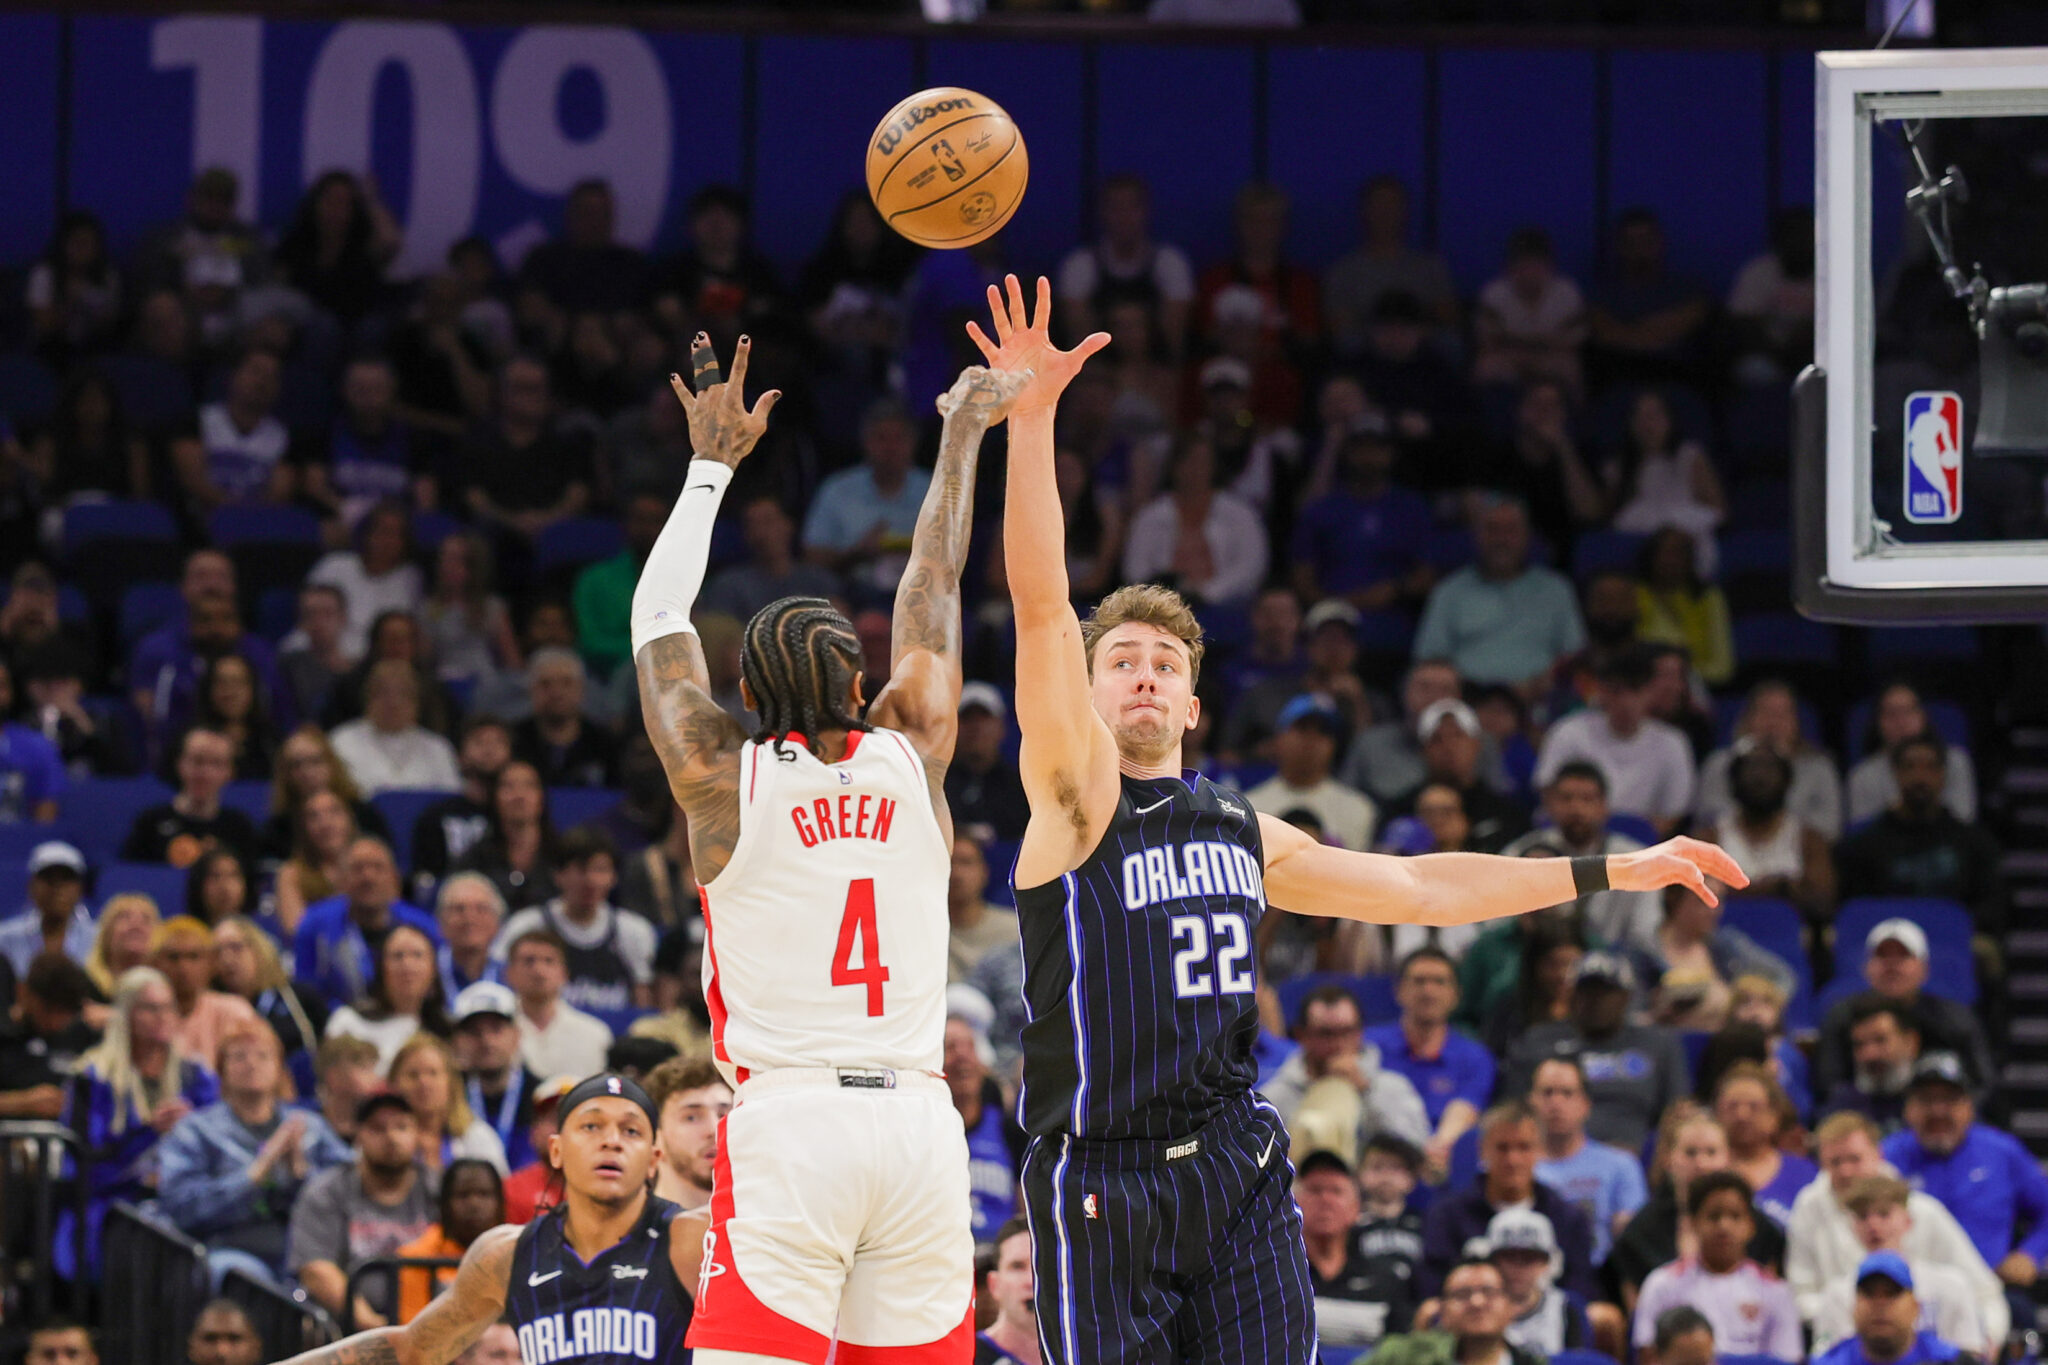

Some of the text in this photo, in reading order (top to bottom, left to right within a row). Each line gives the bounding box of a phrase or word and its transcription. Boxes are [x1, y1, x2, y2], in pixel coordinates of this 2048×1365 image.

[150, 14, 673, 282] 109
[876, 97, 976, 156] Wilson
[1912, 492, 1940, 514] NBA
[791, 794, 896, 848] GREEN
[1122, 840, 1266, 912] ORLANDO
[831, 877, 890, 1018] 4
[1170, 911, 1257, 999] 22
[1165, 1139, 1199, 1161] MAGIC
[518, 1307, 657, 1365] ORLANDO
